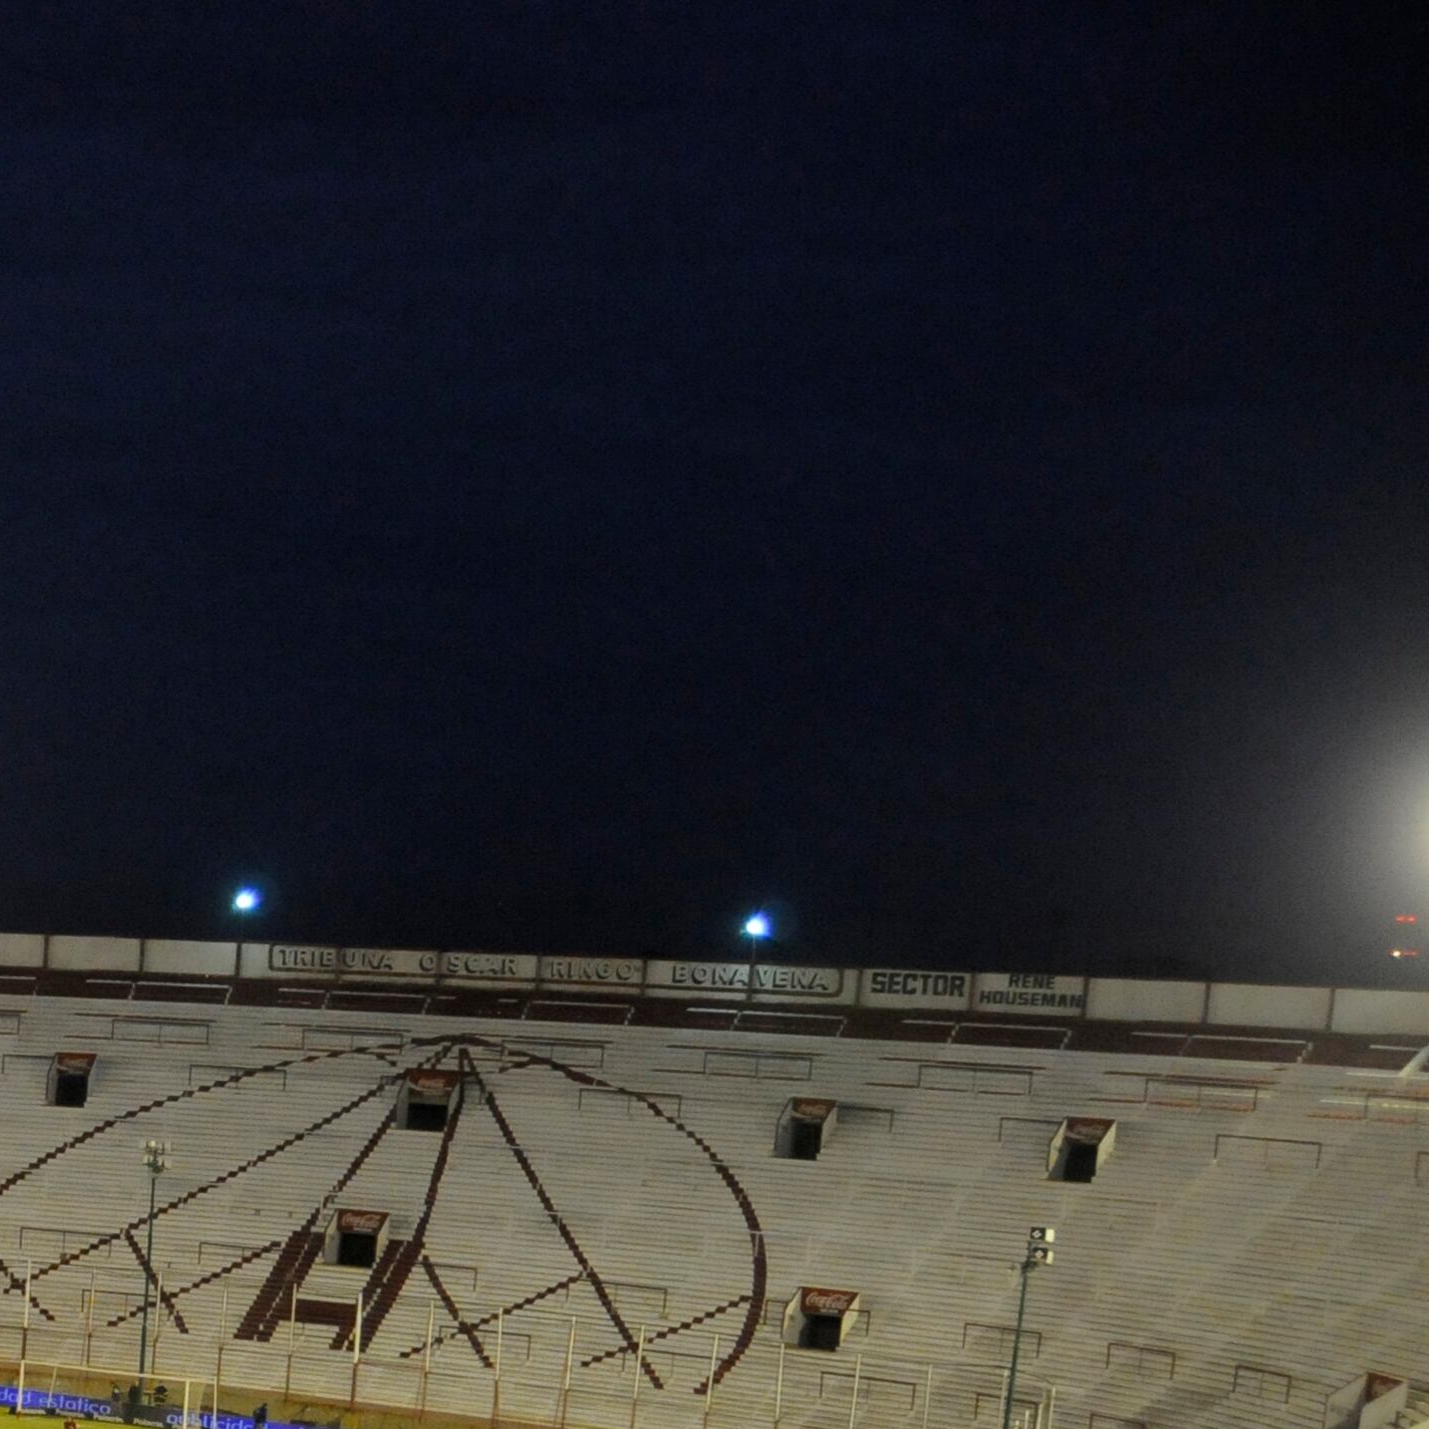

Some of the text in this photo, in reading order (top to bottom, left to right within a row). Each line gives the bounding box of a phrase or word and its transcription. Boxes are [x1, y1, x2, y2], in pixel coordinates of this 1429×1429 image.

[279, 948, 830, 991] TRIBUNA OSCAR RINGO BONAVENA
[870, 971, 965, 998] SECTOR
[1008, 973, 1057, 990] RENE
[978, 988, 1085, 1009] HOUSEMAN
[38, 1394, 112, 1415] estatica
